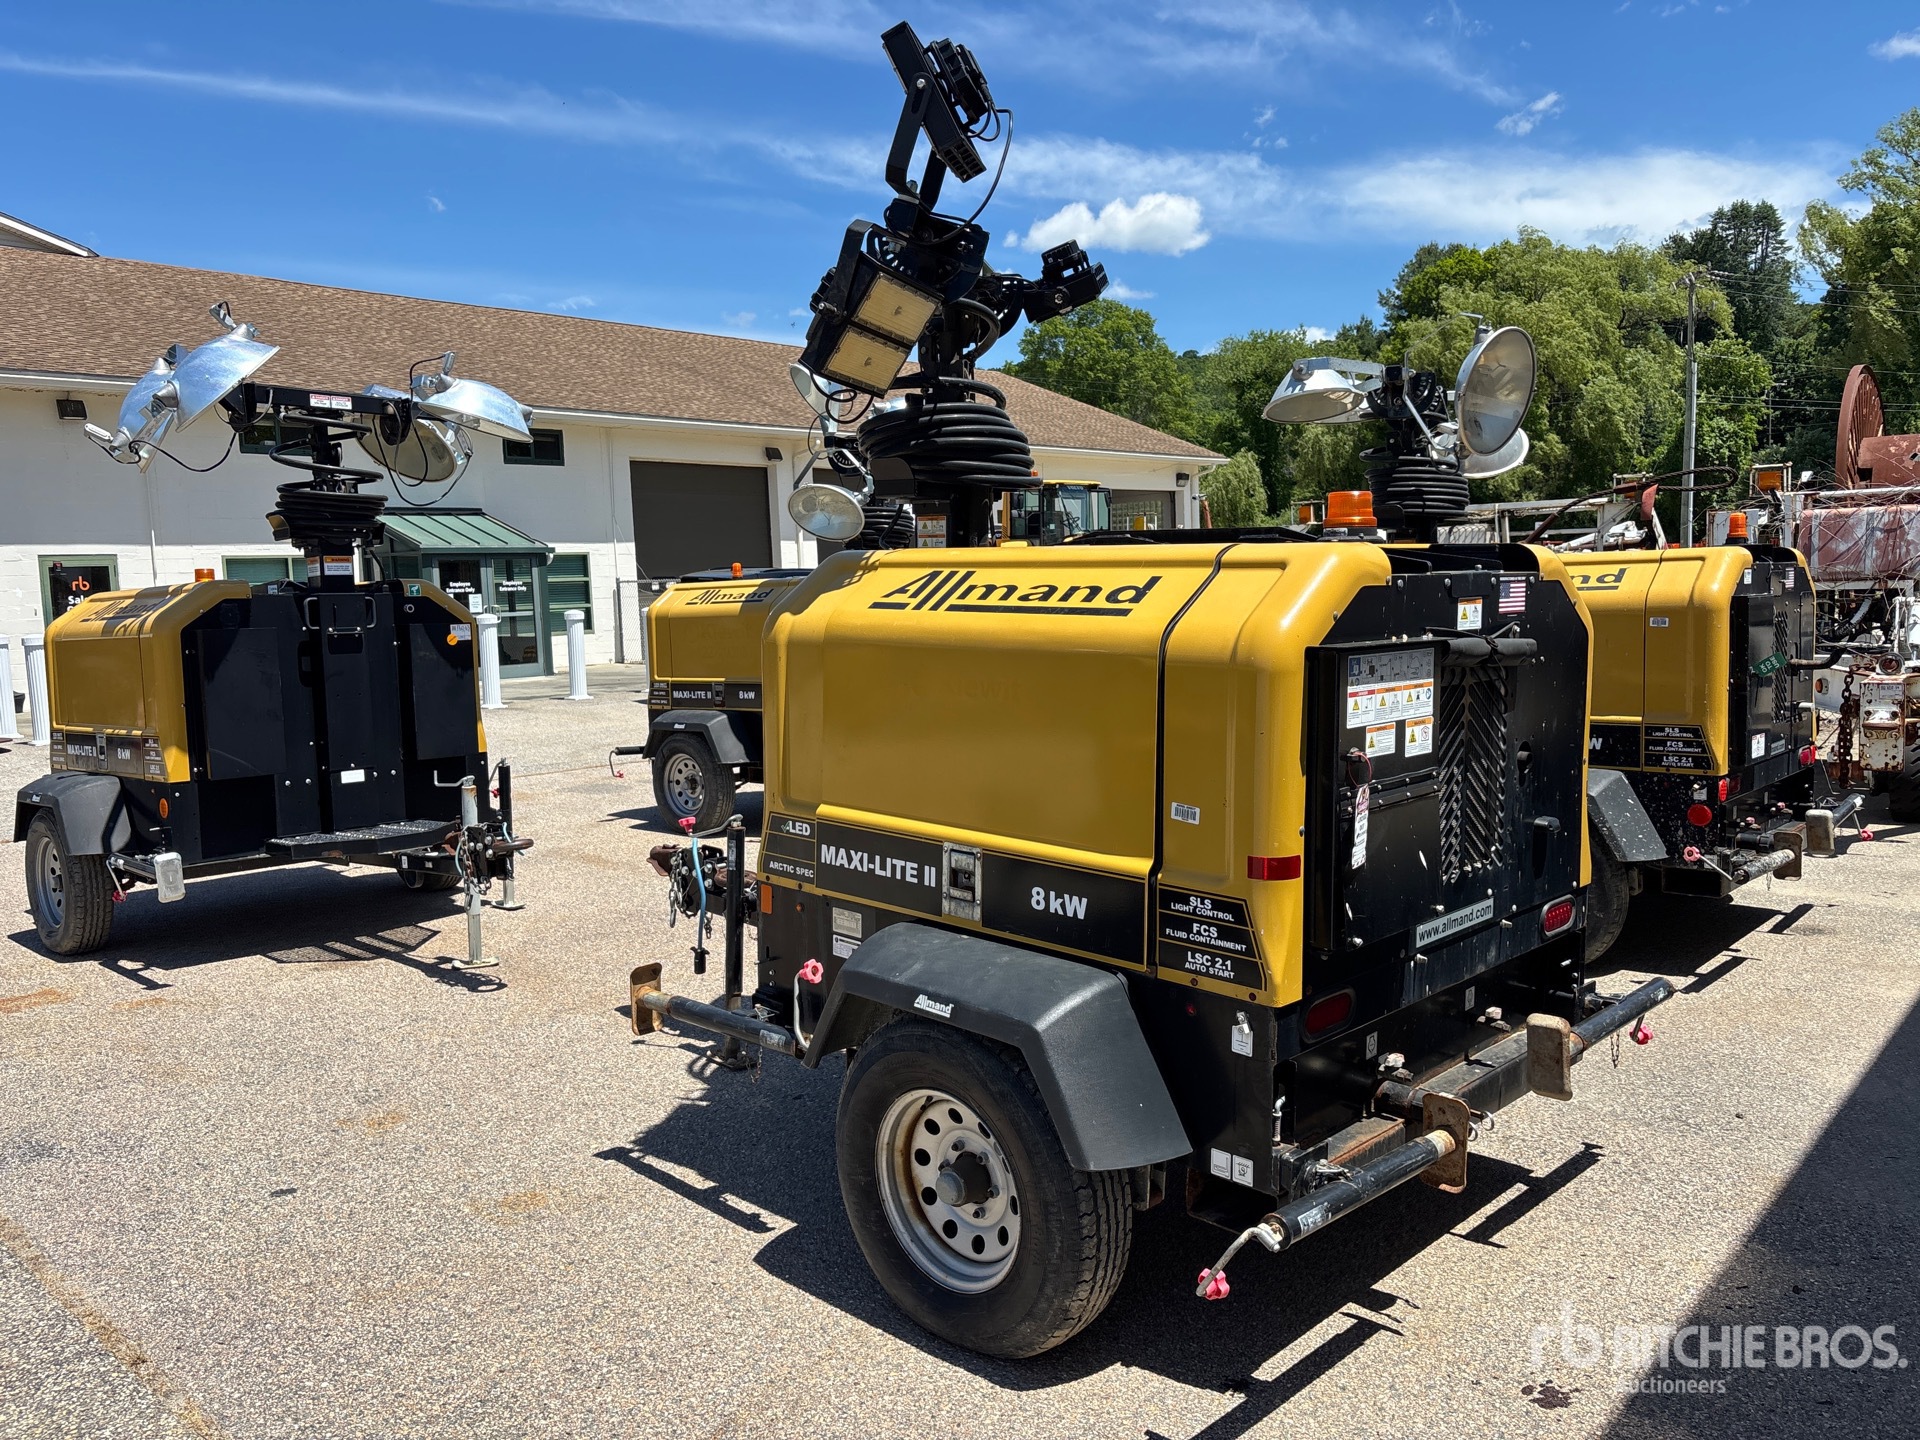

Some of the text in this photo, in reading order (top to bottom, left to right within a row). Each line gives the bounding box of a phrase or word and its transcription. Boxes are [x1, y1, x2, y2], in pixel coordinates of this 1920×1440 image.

[72, 576, 90, 591] rb
[685, 588, 774, 605] Allmand
[868, 570, 1163, 617] Allmand
[673, 690, 706, 699] MAXI-LITE
[789, 820, 811, 836] LED
[769, 861, 814, 878] ARCTIC SPEC
[821, 844, 936, 888] MAXI-LITE II
[1171, 902, 1235, 921] LIGHT CONTROL
[1189, 896, 1212, 910] SLS
[1192, 923, 1218, 938] FCS
[1418, 904, 1492, 942] www.allmand.com
[1166, 928, 1247, 952] FLUID CONTAINMENT
[1184, 961, 1235, 979] AUTO START
[1187, 951, 1232, 971] LSC 2.1
[913, 993, 955, 1019] Allmand
